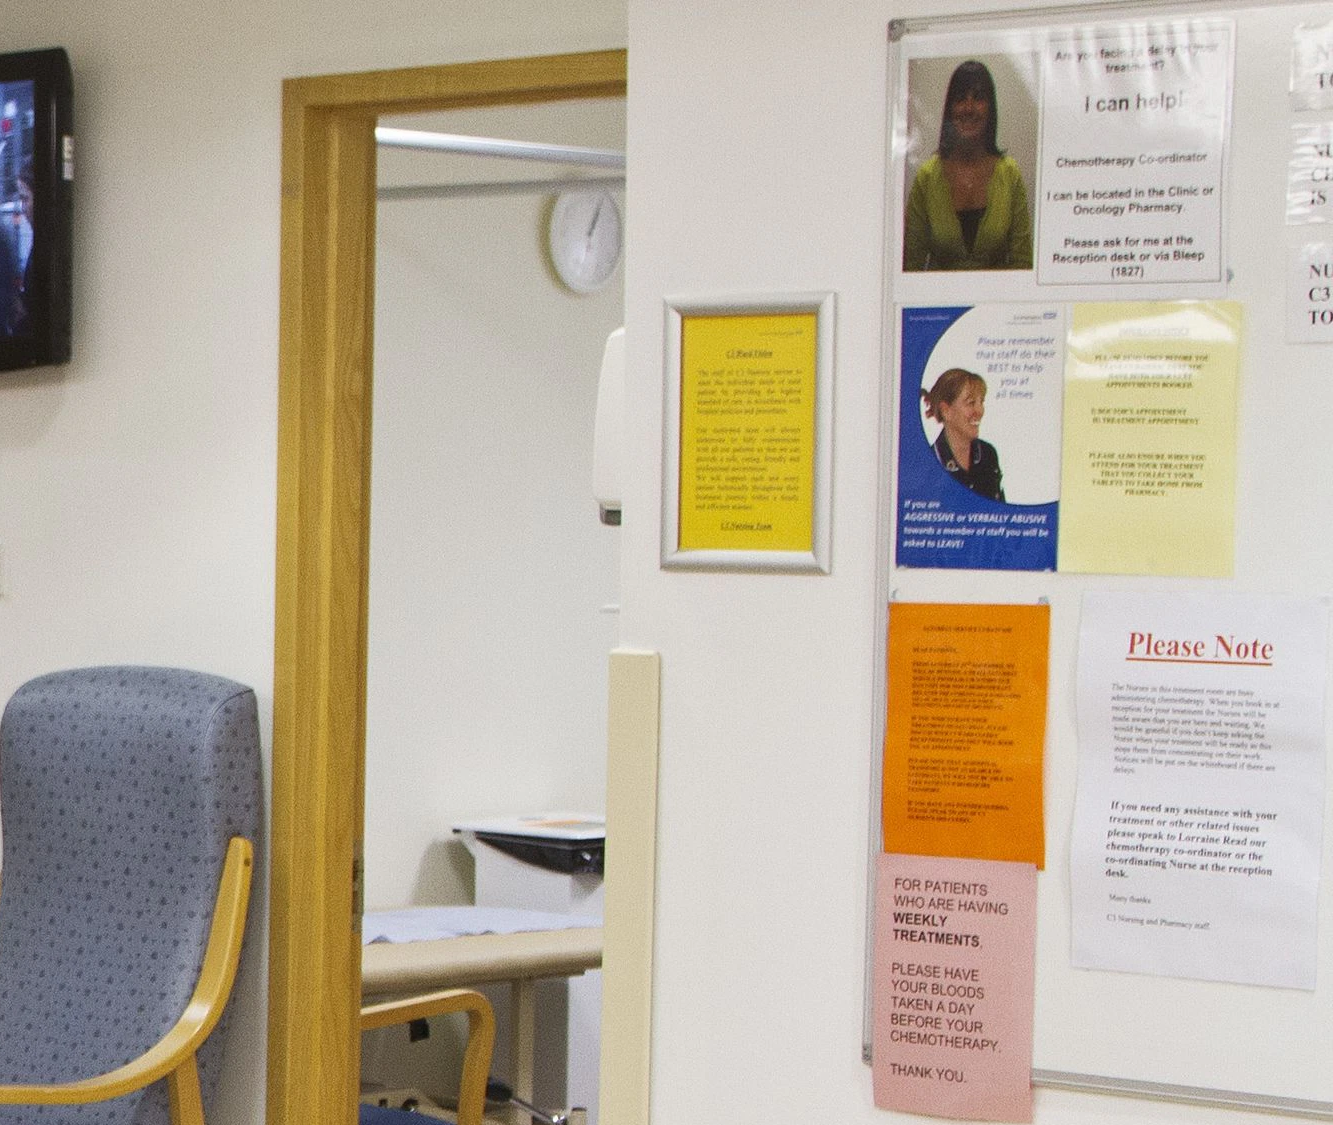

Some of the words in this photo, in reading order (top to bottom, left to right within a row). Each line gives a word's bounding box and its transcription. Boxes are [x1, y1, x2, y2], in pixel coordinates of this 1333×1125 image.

[1085, 96, 1090, 113] I
[1096, 98, 1129, 112] can
[1056, 156, 1135, 168] Chemotherapy
[1139, 153, 1207, 165] Co-ordinator
[1047, 192, 1050, 200] I
[1053, 192, 1072, 200] can
[1076, 191, 1088, 200] be
[1093, 189, 1131, 199] located
[1135, 190, 1144, 198] in
[1148, 188, 1165, 197] the
[1168, 186, 1199, 196] Clinic
[1203, 188, 1213, 196] or
[1073, 204, 1125, 216] Oncology
[1064, 238, 1099, 248] Please
[1103, 238, 1121, 247] ask
[1125, 236, 1139, 246] for
[1143, 238, 1159, 246] me
[1163, 236, 1173, 246] at
[1176, 236, 1193, 244] the
[1053, 253, 1107, 264] Reception
[1110, 252, 1135, 262] desk
[1139, 253, 1149, 261] or
[1154, 252, 1169, 260] via
[1173, 250, 1204, 262] Bleep
[1309, 287, 1331, 302] C3
[977, 337, 1005, 345] Please
[1008, 336, 1054, 345] remember
[976, 350, 995, 359] that
[997, 350, 1018, 360] staff
[1019, 350, 1031, 359] do
[1034, 350, 1055, 359] their
[987, 364, 1009, 372] BEST
[1012, 364, 1021, 372] to
[1024, 363, 1043, 373] help
[1019, 378, 1029, 386] at
[1009, 391, 1033, 399] times
[904, 500, 910, 508] If
[911, 502, 925, 510] you
[904, 512, 955, 522] AGGRESSIVE
[967, 513, 1007, 523] VERBALLY
[1011, 514, 1047, 524] ABUSIVE
[903, 526, 934, 534] towards
[943, 527, 975, 535] member
[976, 527, 985, 536] of
[987, 528, 1005, 536] staff
[1005, 529, 1021, 538] you
[1023, 528, 1037, 536] will
[1039, 529, 1049, 537] be
[903, 540, 925, 548] asked
[927, 540, 935, 548] to
[937, 540, 965, 548] LEAVE!
[1128, 632, 1205, 658] Please
[1214, 634, 1274, 660] Note
[1111, 801, 1119, 810] If
[1121, 804, 1137, 812] you
[1141, 804, 1161, 813] need
[1165, 806, 1180, 815] any
[1184, 806, 1229, 817] assistance
[1233, 808, 1252, 818] with
[1256, 812, 1277, 821] your
[1109, 815, 1154, 826] treatment
[1157, 818, 1167, 826] or
[1169, 818, 1193, 828] other
[1197, 820, 1229, 830] related
[1233, 822, 1259, 832] issues
[1107, 828, 1135, 838] please
[1138, 831, 1163, 842] speak
[1167, 832, 1175, 840] to
[1179, 832, 1220, 844] Lorraine
[1223, 836, 1247, 846] Read
[1249, 839, 1266, 848] our
[1105, 842, 1170, 856] chemotherapy
[1173, 846, 1231, 858] co-ordinator
[1235, 851, 1245, 859] or
[1249, 851, 1263, 860] the
[1105, 856, 1167, 869] co-ordinating
[1169, 859, 1197, 870] Nurse
[1199, 862, 1209, 870] at
[1211, 862, 1225, 872] the
[1229, 864, 1273, 876] reception
[1105, 868, 1129, 878] desk.
[894, 878, 921, 890] FOR
[925, 880, 987, 896] PATIENTS
[894, 895, 925, 909] WHO
[928, 898, 955, 911] ARE
[958, 900, 1009, 916] HAVING
[893, 912, 947, 927] WEEKLY
[893, 929, 983, 949] TREATMENTS.
[891, 962, 941, 978] PLEASE
[944, 967, 979, 982] HAVE
[891, 980, 927, 994] YOUR
[931, 983, 985, 1000] BLOODS
[891, 996, 933, 1010] TAKEN
[936, 1001, 945, 1013] A
[949, 1002, 975, 1016] DAY
[891, 1013, 941, 1030] BEFORE
[946, 1018, 983, 1034] YOUR
[890, 1030, 1001, 1053] CHEMOTHERAPY.
[890, 1062, 933, 1078] THANK
[936, 1068, 967, 1083] YOU.
